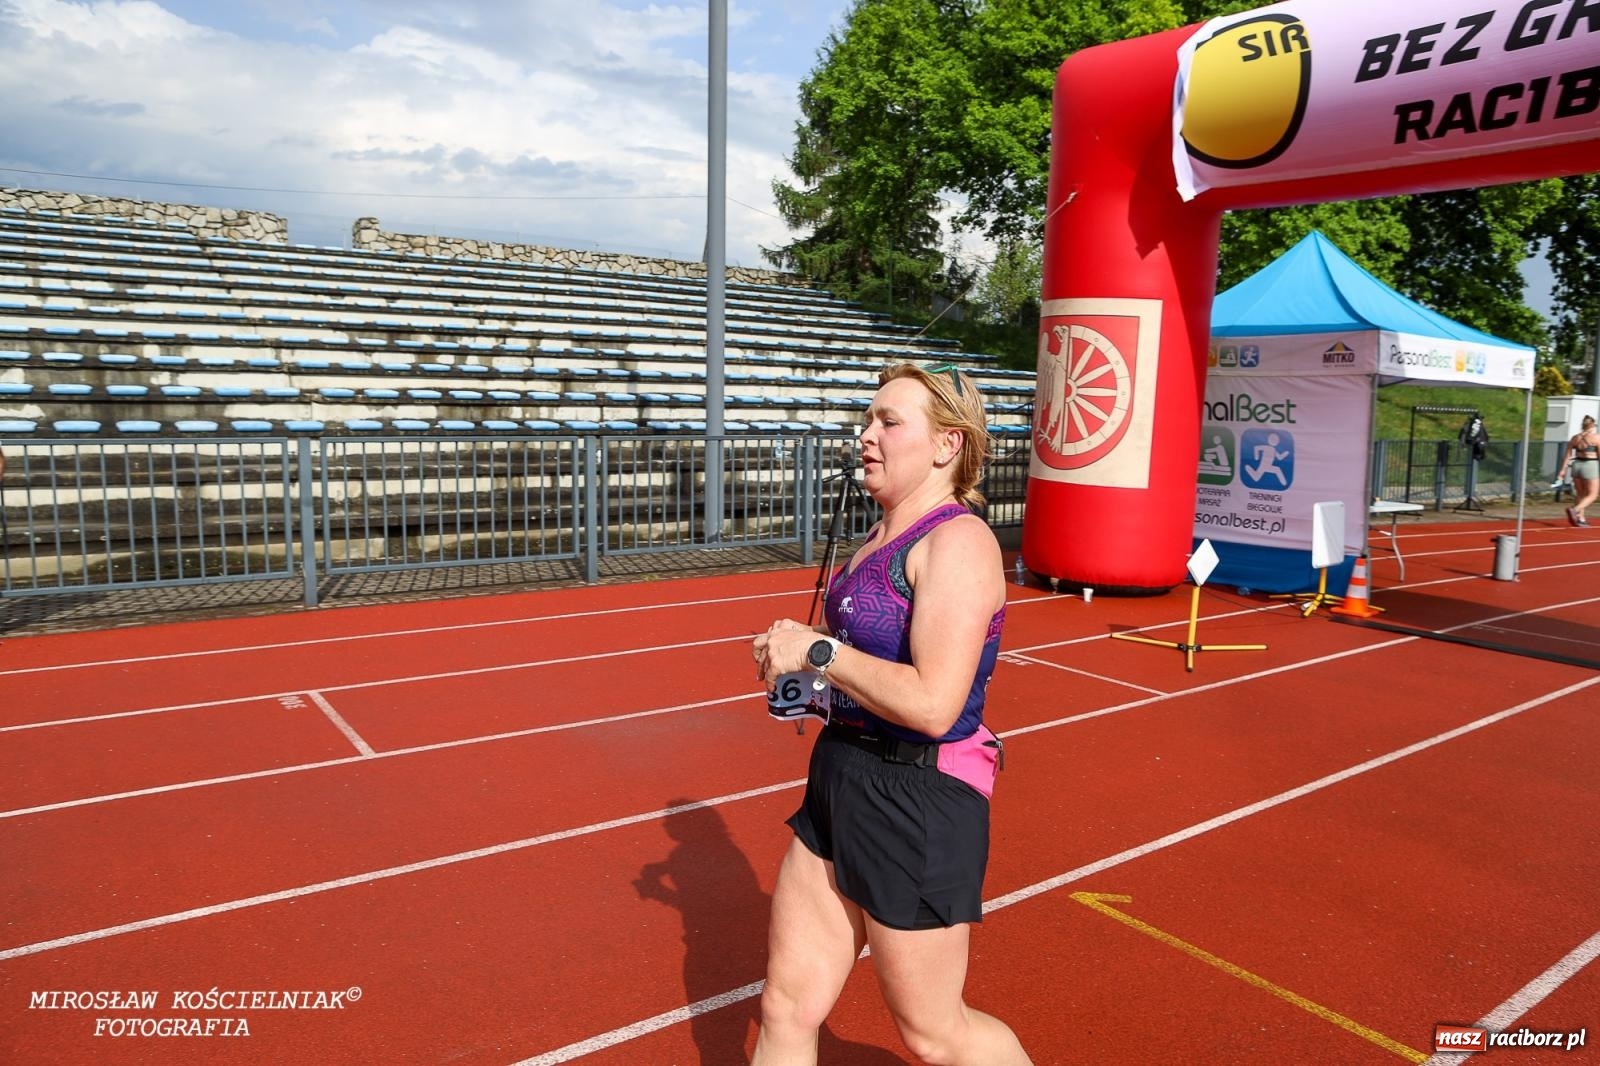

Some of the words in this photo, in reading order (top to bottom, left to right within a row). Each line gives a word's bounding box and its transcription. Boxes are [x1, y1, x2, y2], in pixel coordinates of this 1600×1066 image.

[1238, 24, 1309, 62] SIR
[1354, 10, 1496, 84] BEZ
[1322, 352, 1356, 364] MITKO
[1248, 491, 1283, 503] TRENINGI
[1246, 502, 1283, 514] BIEGOWE
